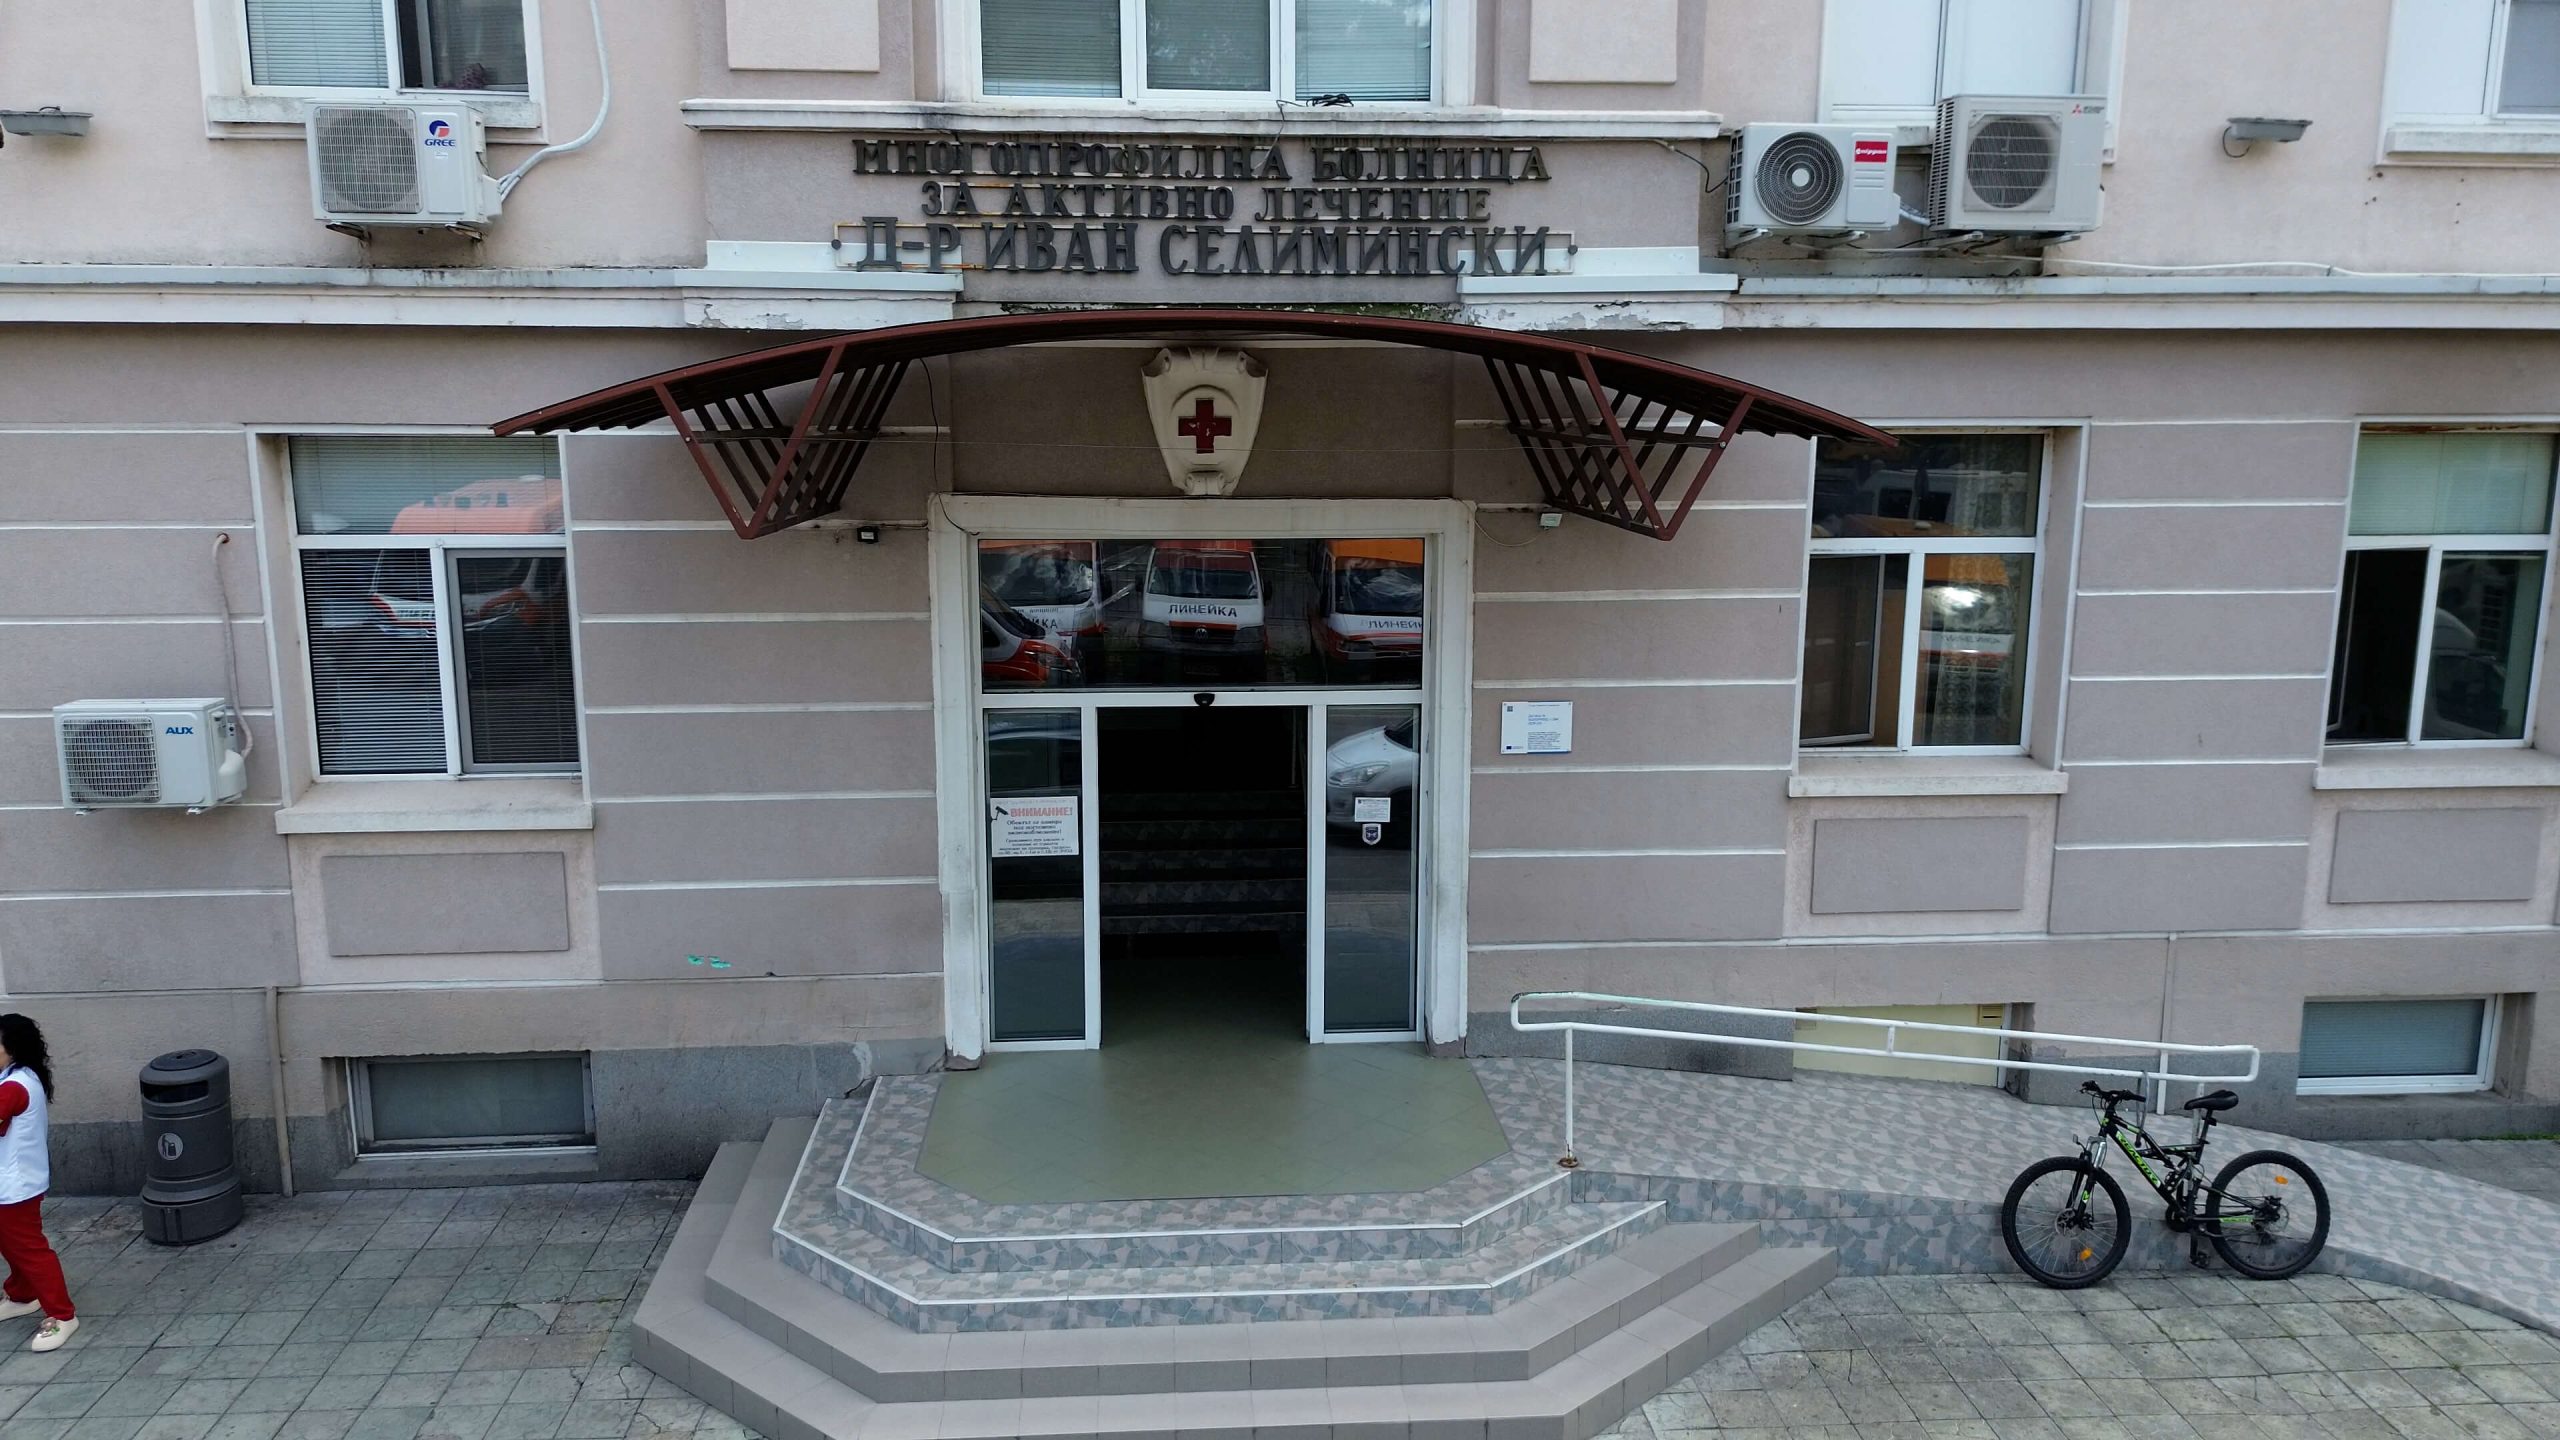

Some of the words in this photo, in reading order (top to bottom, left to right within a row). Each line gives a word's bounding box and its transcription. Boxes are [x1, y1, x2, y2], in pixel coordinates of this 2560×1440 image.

[424, 138, 457, 147] GREE
[852, 139, 1293, 180] МНОГОПРОФИЛНА
[1311, 146, 1552, 184] БОЛНИЦА
[921, 180, 979, 216] ЗА
[1004, 183, 1234, 220] АКТИВНО
[1254, 186, 1491, 222] ЛЕЧЕНИЕ
[856, 216, 962, 273] Д-Р
[981, 221, 1139, 274] ИВАН
[1160, 224, 1550, 276] СЕЛИМИНСКИ
[1168, 604, 1238, 618] ЛИНЕЙКА
[165, 726, 194, 735] AUX
[1010, 807, 1073, 817] ВНИМАНИЕ!
